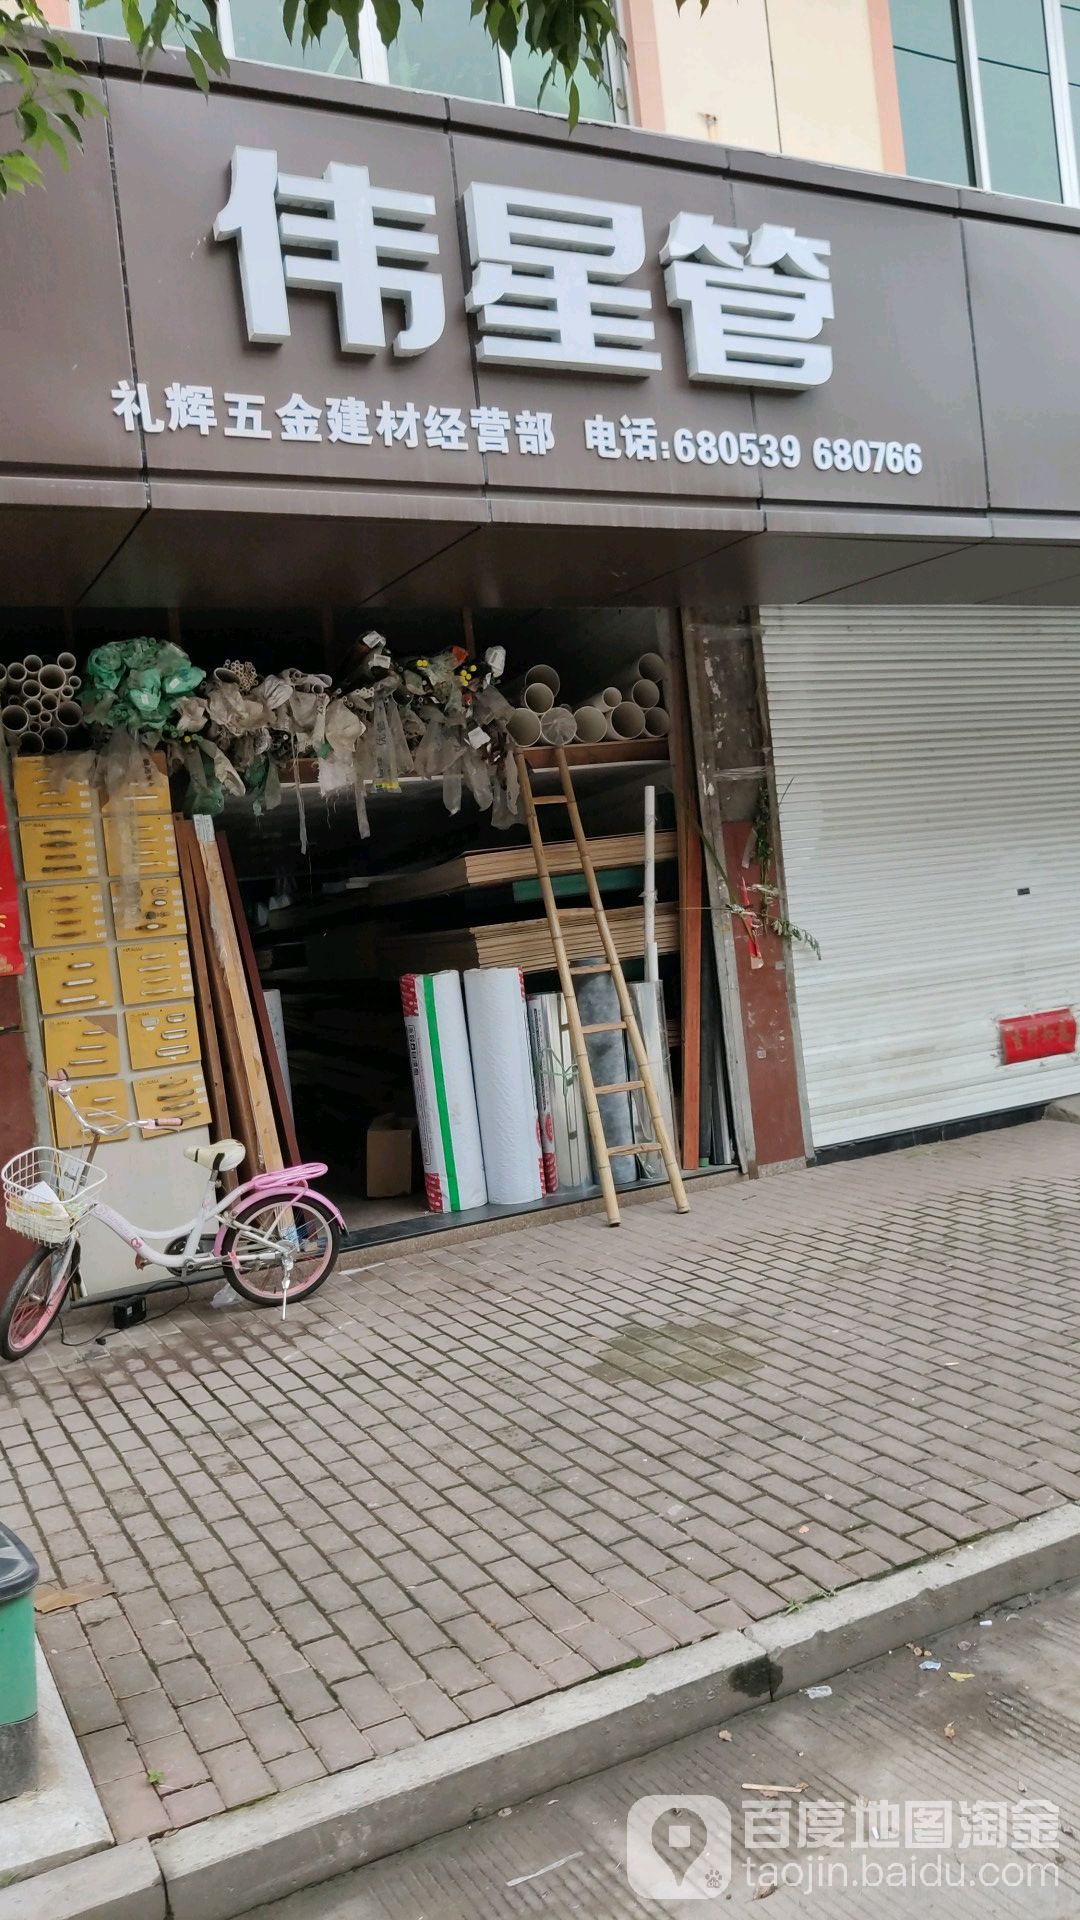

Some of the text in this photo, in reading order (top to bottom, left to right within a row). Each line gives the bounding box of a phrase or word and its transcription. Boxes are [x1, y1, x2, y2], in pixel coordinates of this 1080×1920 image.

[213, 145, 834, 391] 伟星管
[111, 379, 555, 456] 礼辉五金建材经营部
[812, 437, 922, 475] 680766
